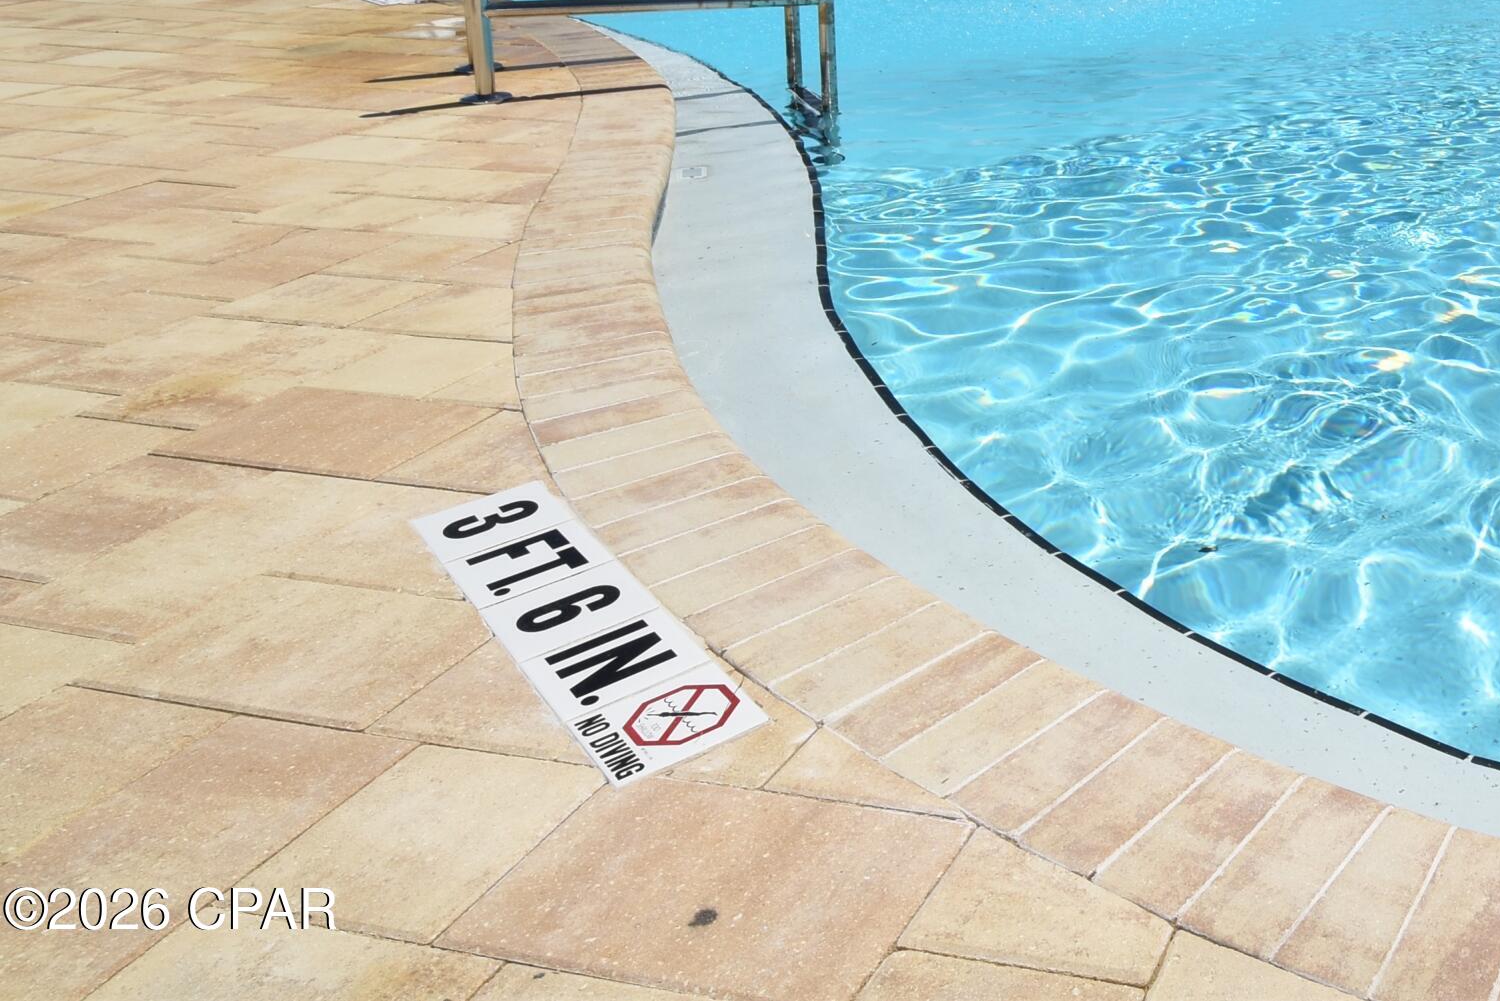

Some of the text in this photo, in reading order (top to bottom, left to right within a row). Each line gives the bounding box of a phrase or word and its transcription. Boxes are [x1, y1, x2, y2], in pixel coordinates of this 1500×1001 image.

[442, 500, 678, 707] 3 FT. 6 IN.
[574, 713, 645, 781] NO DIVING
